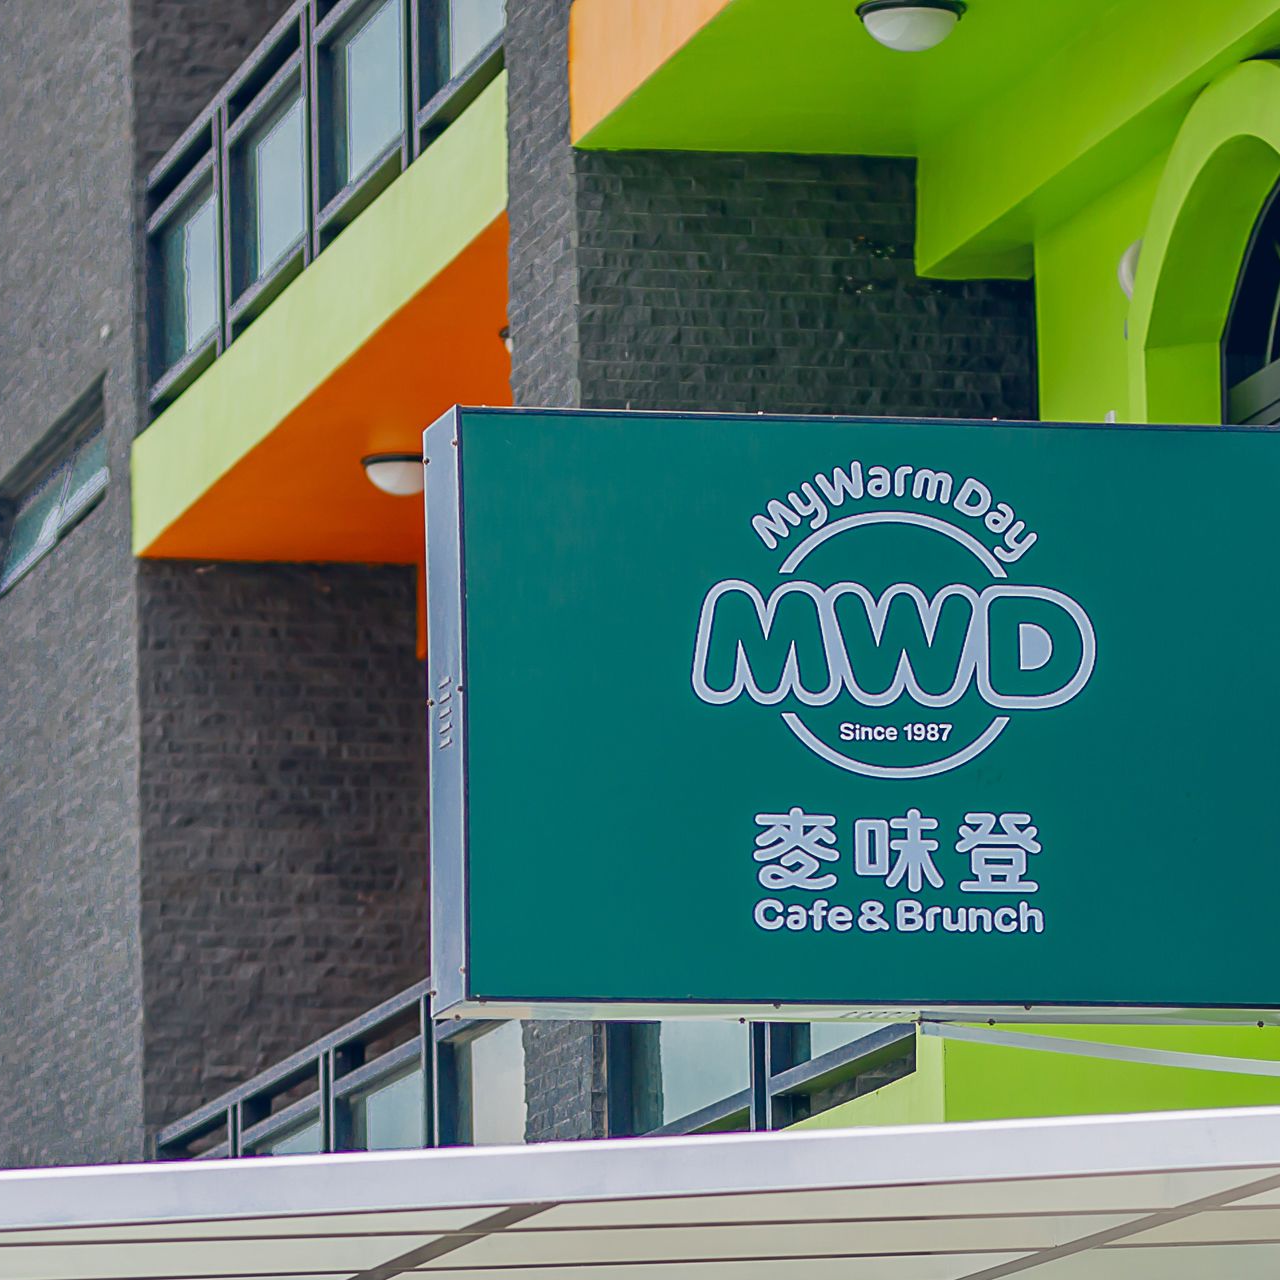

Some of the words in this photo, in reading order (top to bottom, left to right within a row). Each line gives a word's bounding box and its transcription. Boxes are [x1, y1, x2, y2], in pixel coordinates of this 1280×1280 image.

[691, 579, 1096, 709] MWD
[839, 722, 899, 743] Since
[903, 722, 953, 743] 1987
[753, 807, 1042, 894] 麥味登
